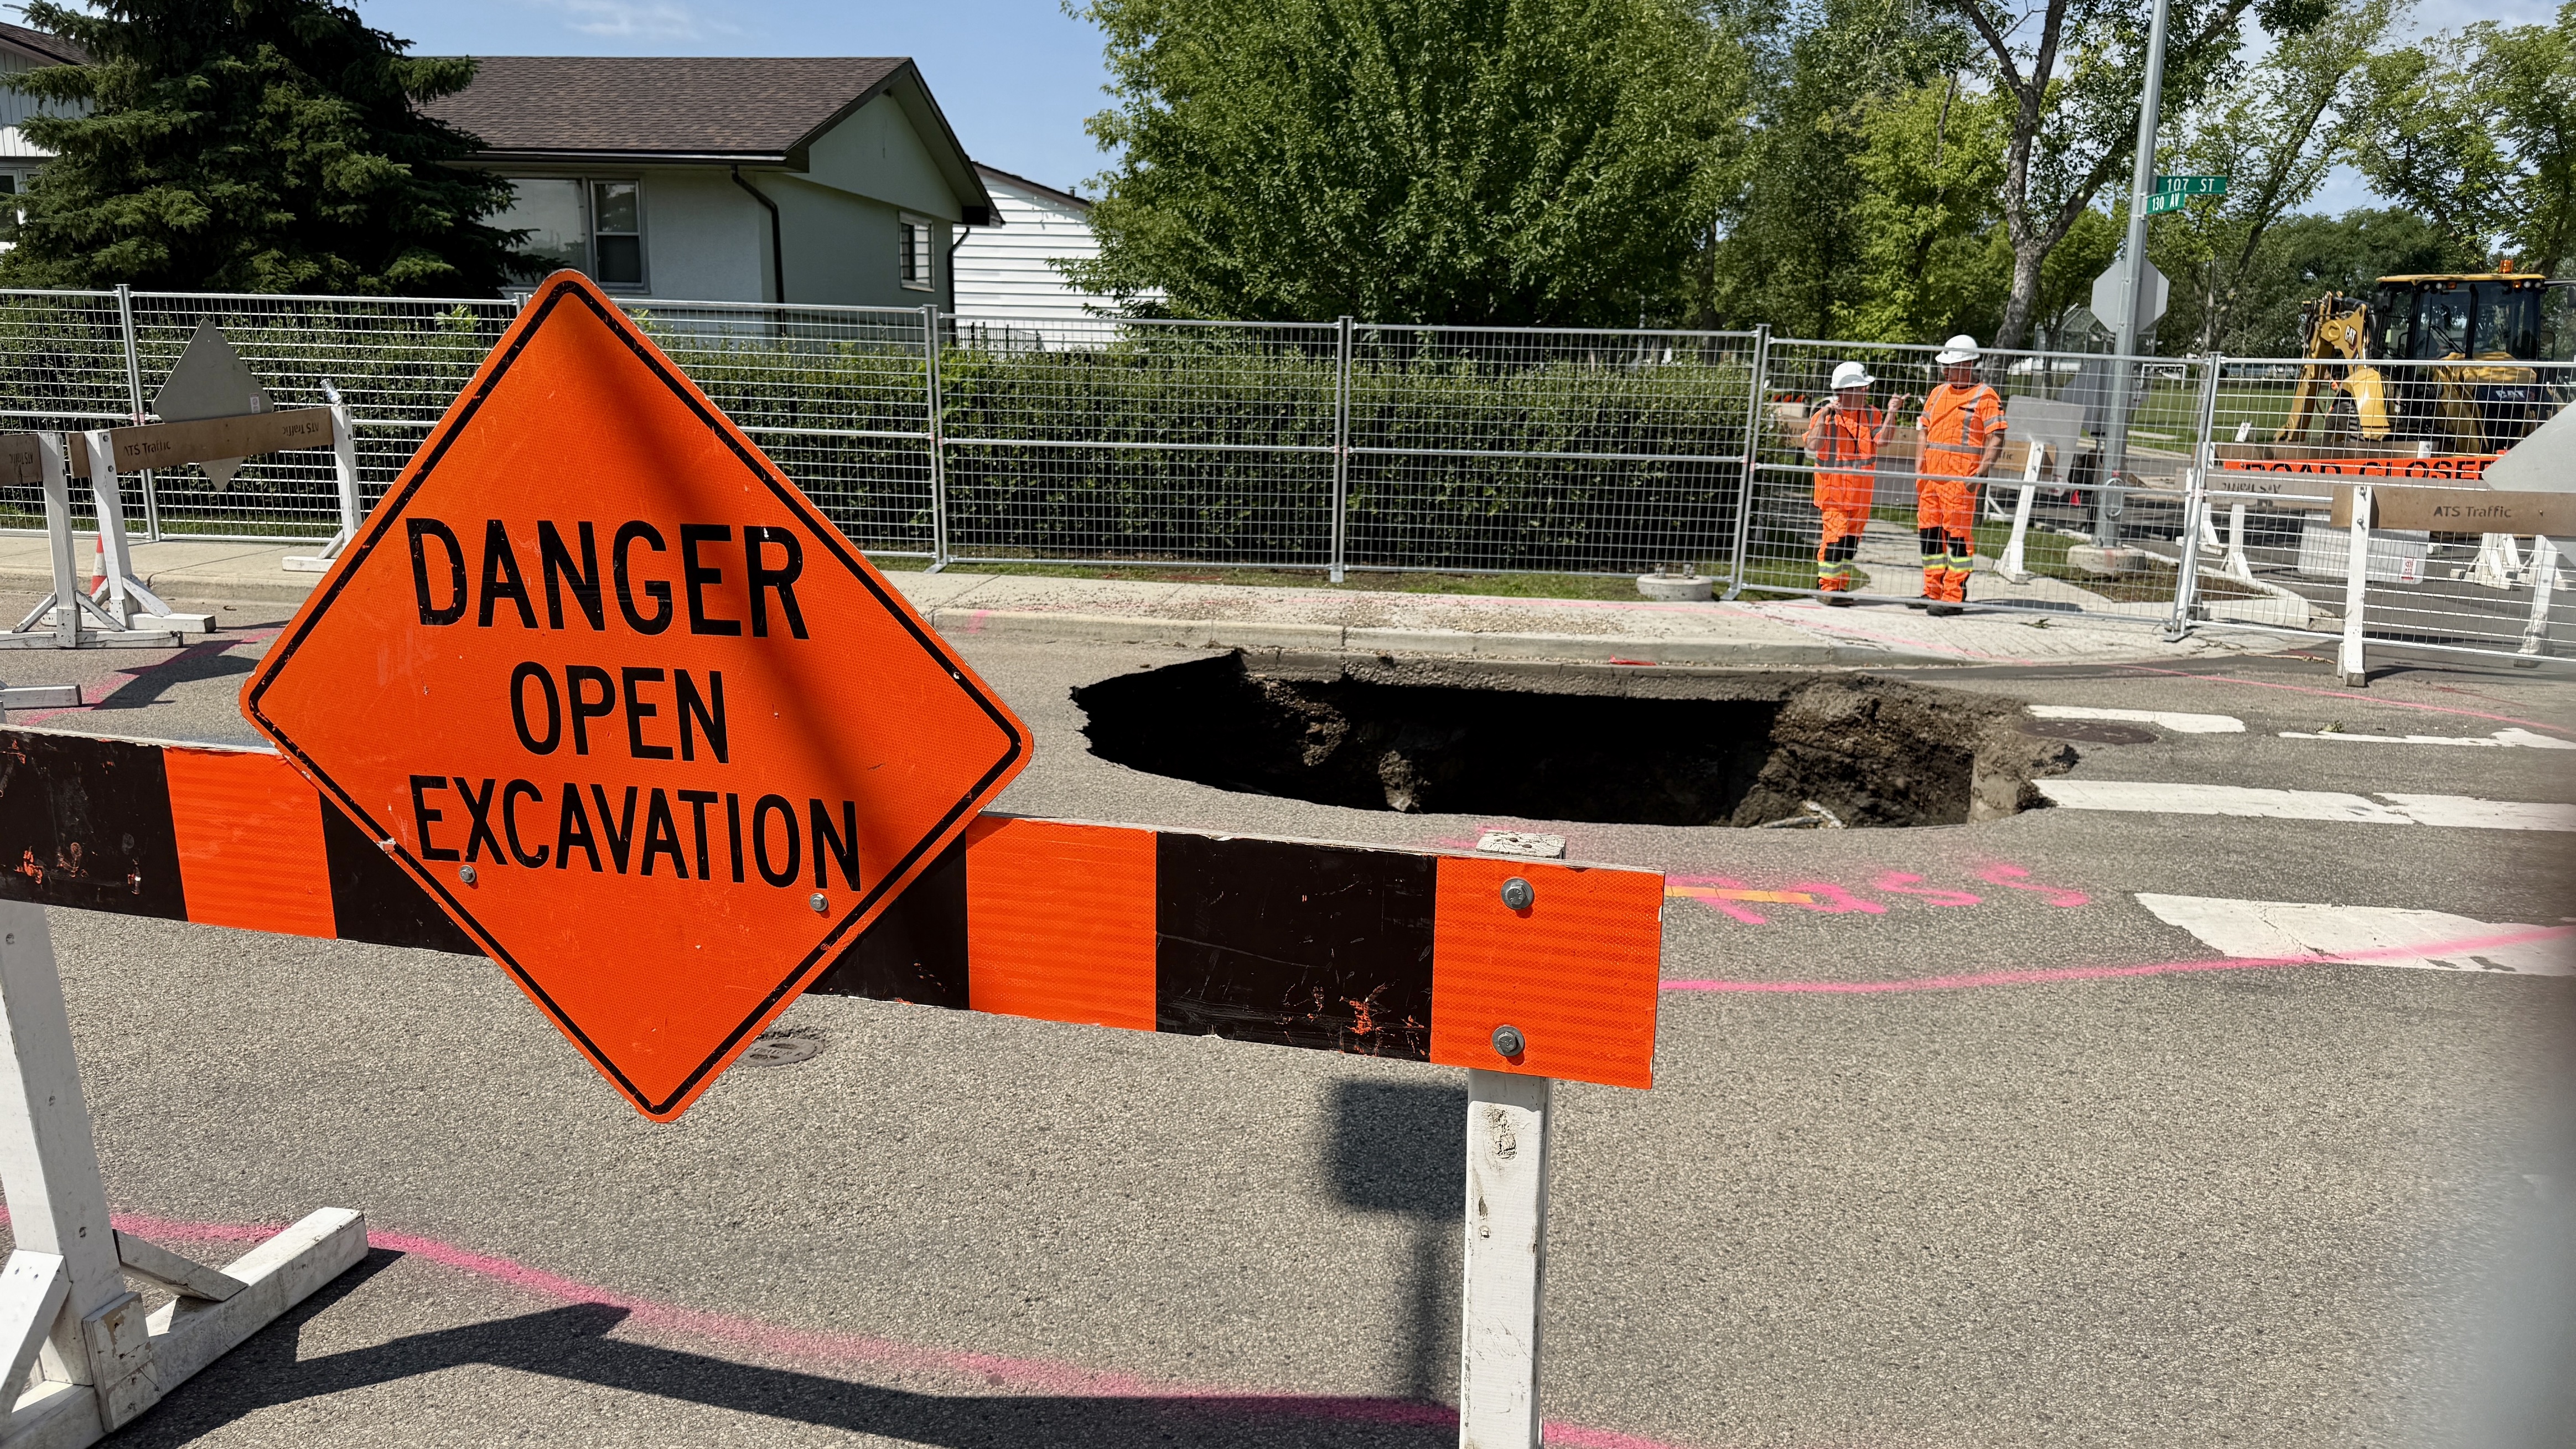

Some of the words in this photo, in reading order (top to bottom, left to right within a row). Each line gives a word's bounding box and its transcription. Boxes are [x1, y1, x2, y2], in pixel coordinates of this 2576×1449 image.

[2167, 178, 2189, 192] 107
[2200, 178, 2215, 192] ST
[2152, 195, 2164, 211] 130
[2170, 192, 2180, 208] AV
[2345, 325, 2357, 345] CAT
[2496, 390, 2525, 399] CAT
[2433, 506, 2460, 517] ATS
[2465, 505, 2512, 518] Traffic
[405, 518, 809, 640] DANGER
[509, 661, 729, 764] OPEN
[409, 775, 862, 892] EXCAVATION
